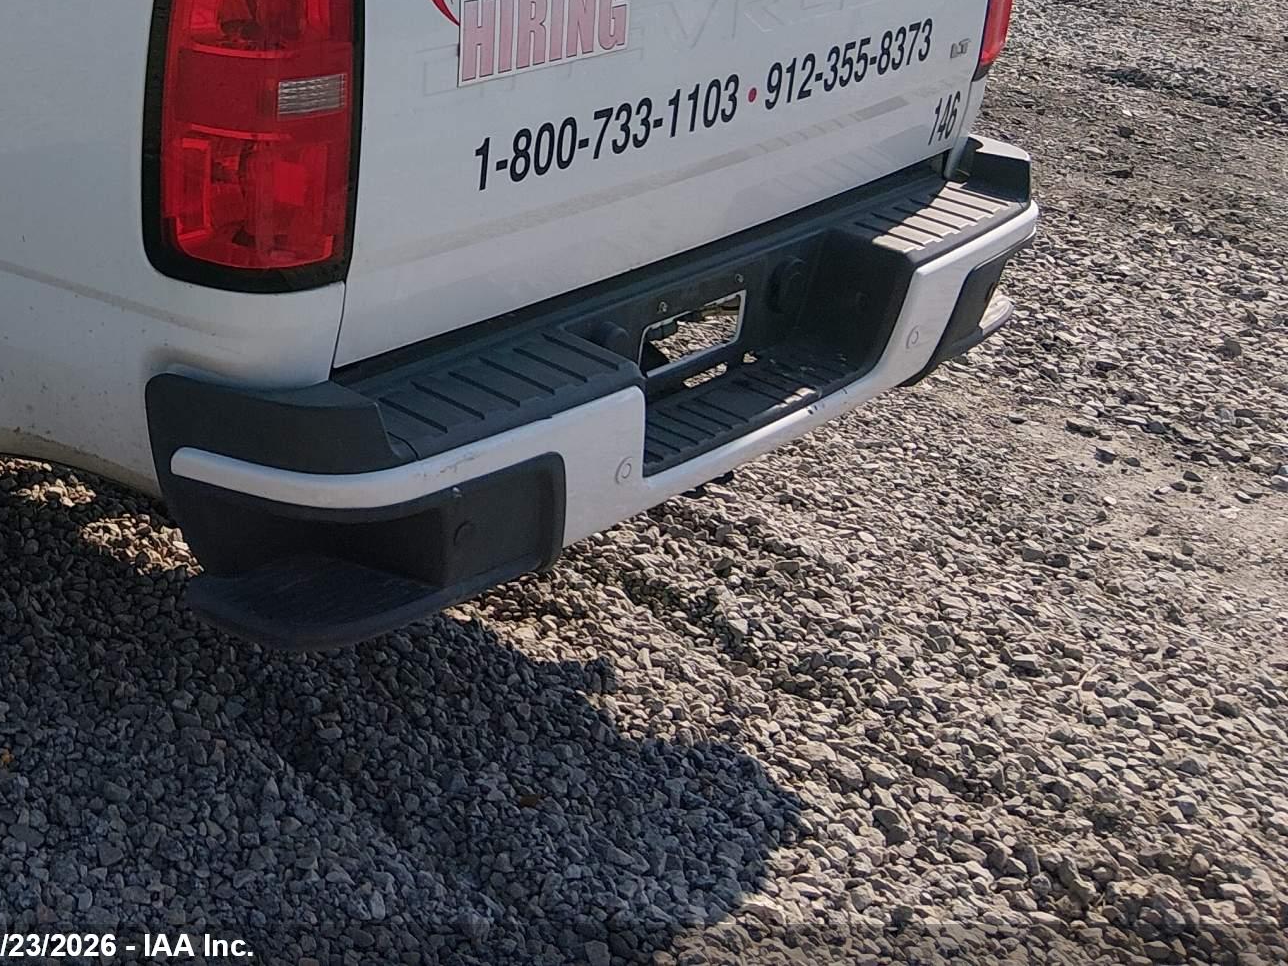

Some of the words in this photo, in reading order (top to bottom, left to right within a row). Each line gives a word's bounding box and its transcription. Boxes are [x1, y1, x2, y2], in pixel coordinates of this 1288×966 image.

[474, 73, 740, 192] 1-800-733-1103
[765, 17, 934, 110] 912-355-8373
[927, 90, 962, 147] 146
